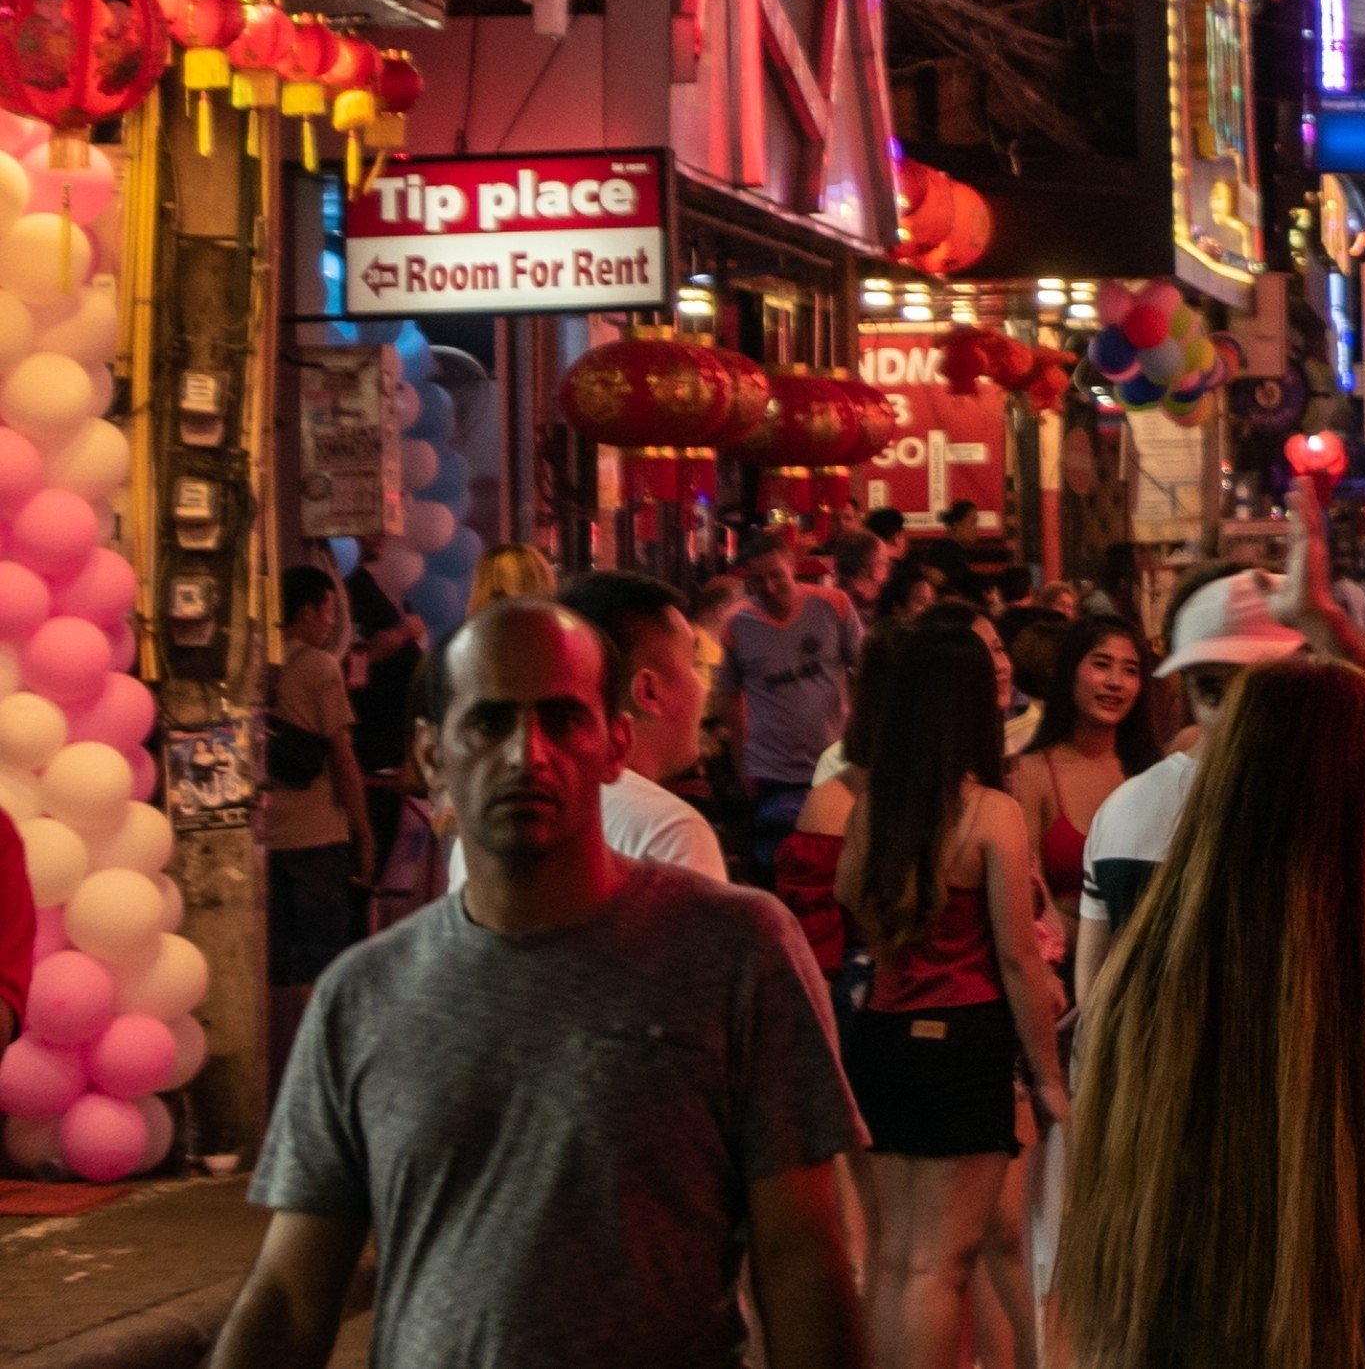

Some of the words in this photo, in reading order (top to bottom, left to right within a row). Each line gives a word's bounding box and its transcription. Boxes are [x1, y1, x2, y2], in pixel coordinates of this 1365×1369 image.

[373, 173, 468, 234] Tip
[477, 168, 639, 231] place
[404, 254, 500, 293] Room
[508, 250, 564, 289] For
[571, 245, 650, 288] Rent
